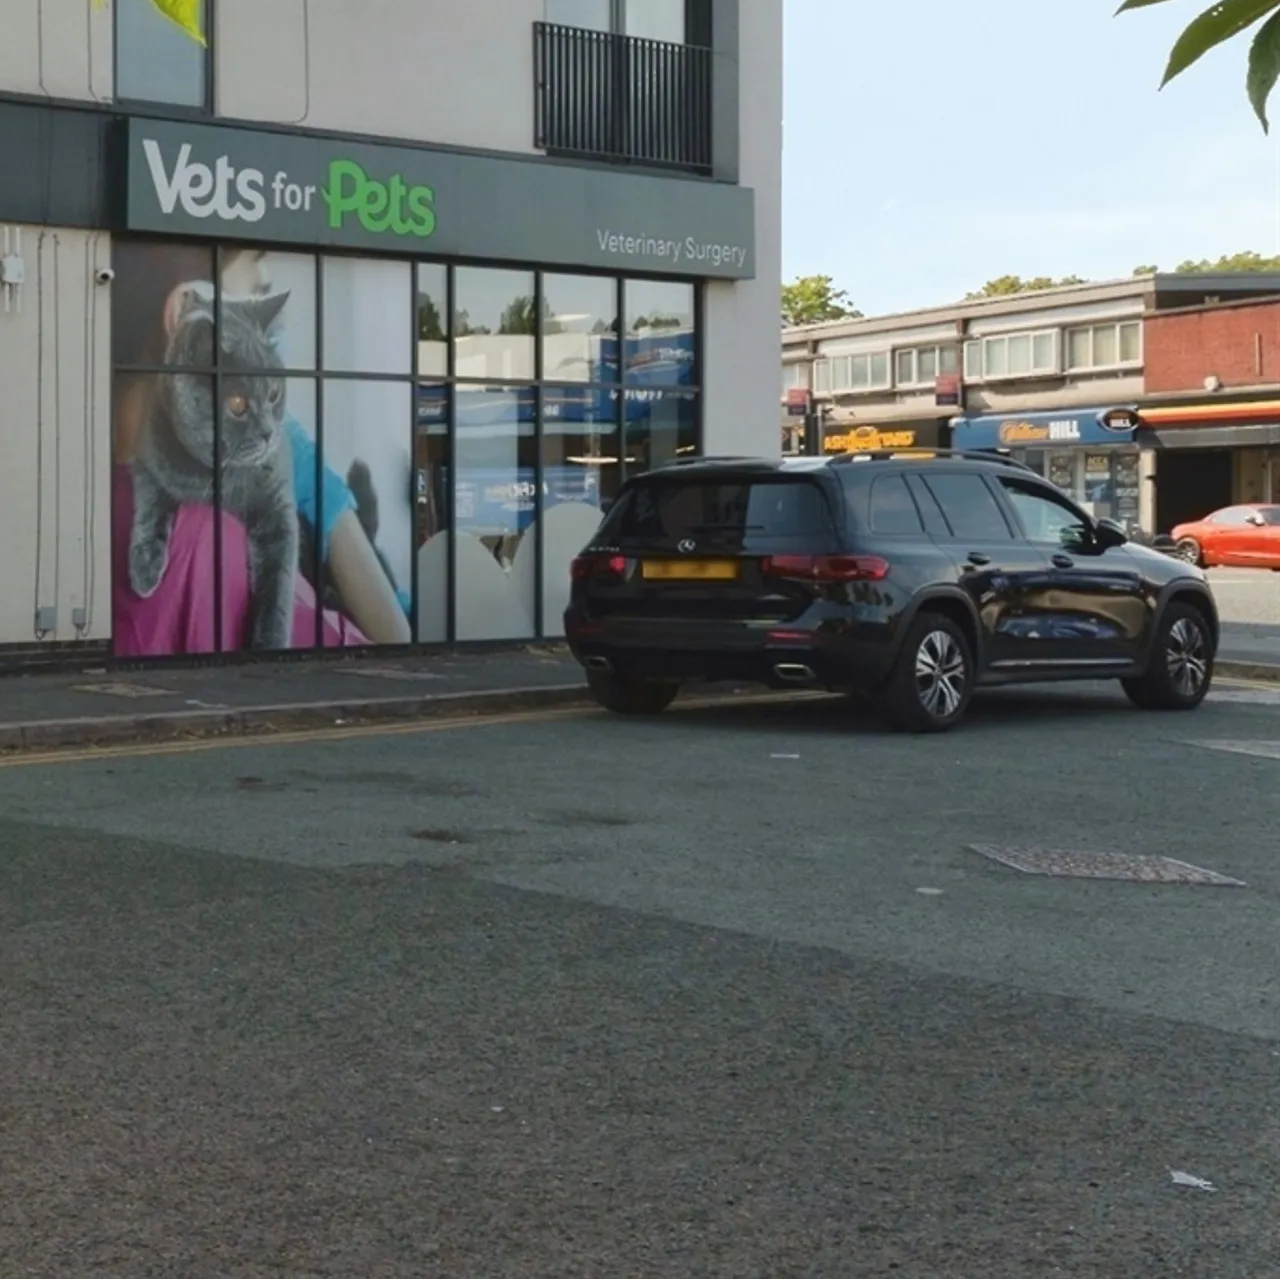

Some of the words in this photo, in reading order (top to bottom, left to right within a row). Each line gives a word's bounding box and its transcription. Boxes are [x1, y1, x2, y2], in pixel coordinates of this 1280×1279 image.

[142, 139, 266, 222] Vets
[271, 171, 316, 211] for
[321, 158, 436, 237] Pets
[596, 228, 682, 263] Veterinary
[685, 236, 747, 268] Surgery
